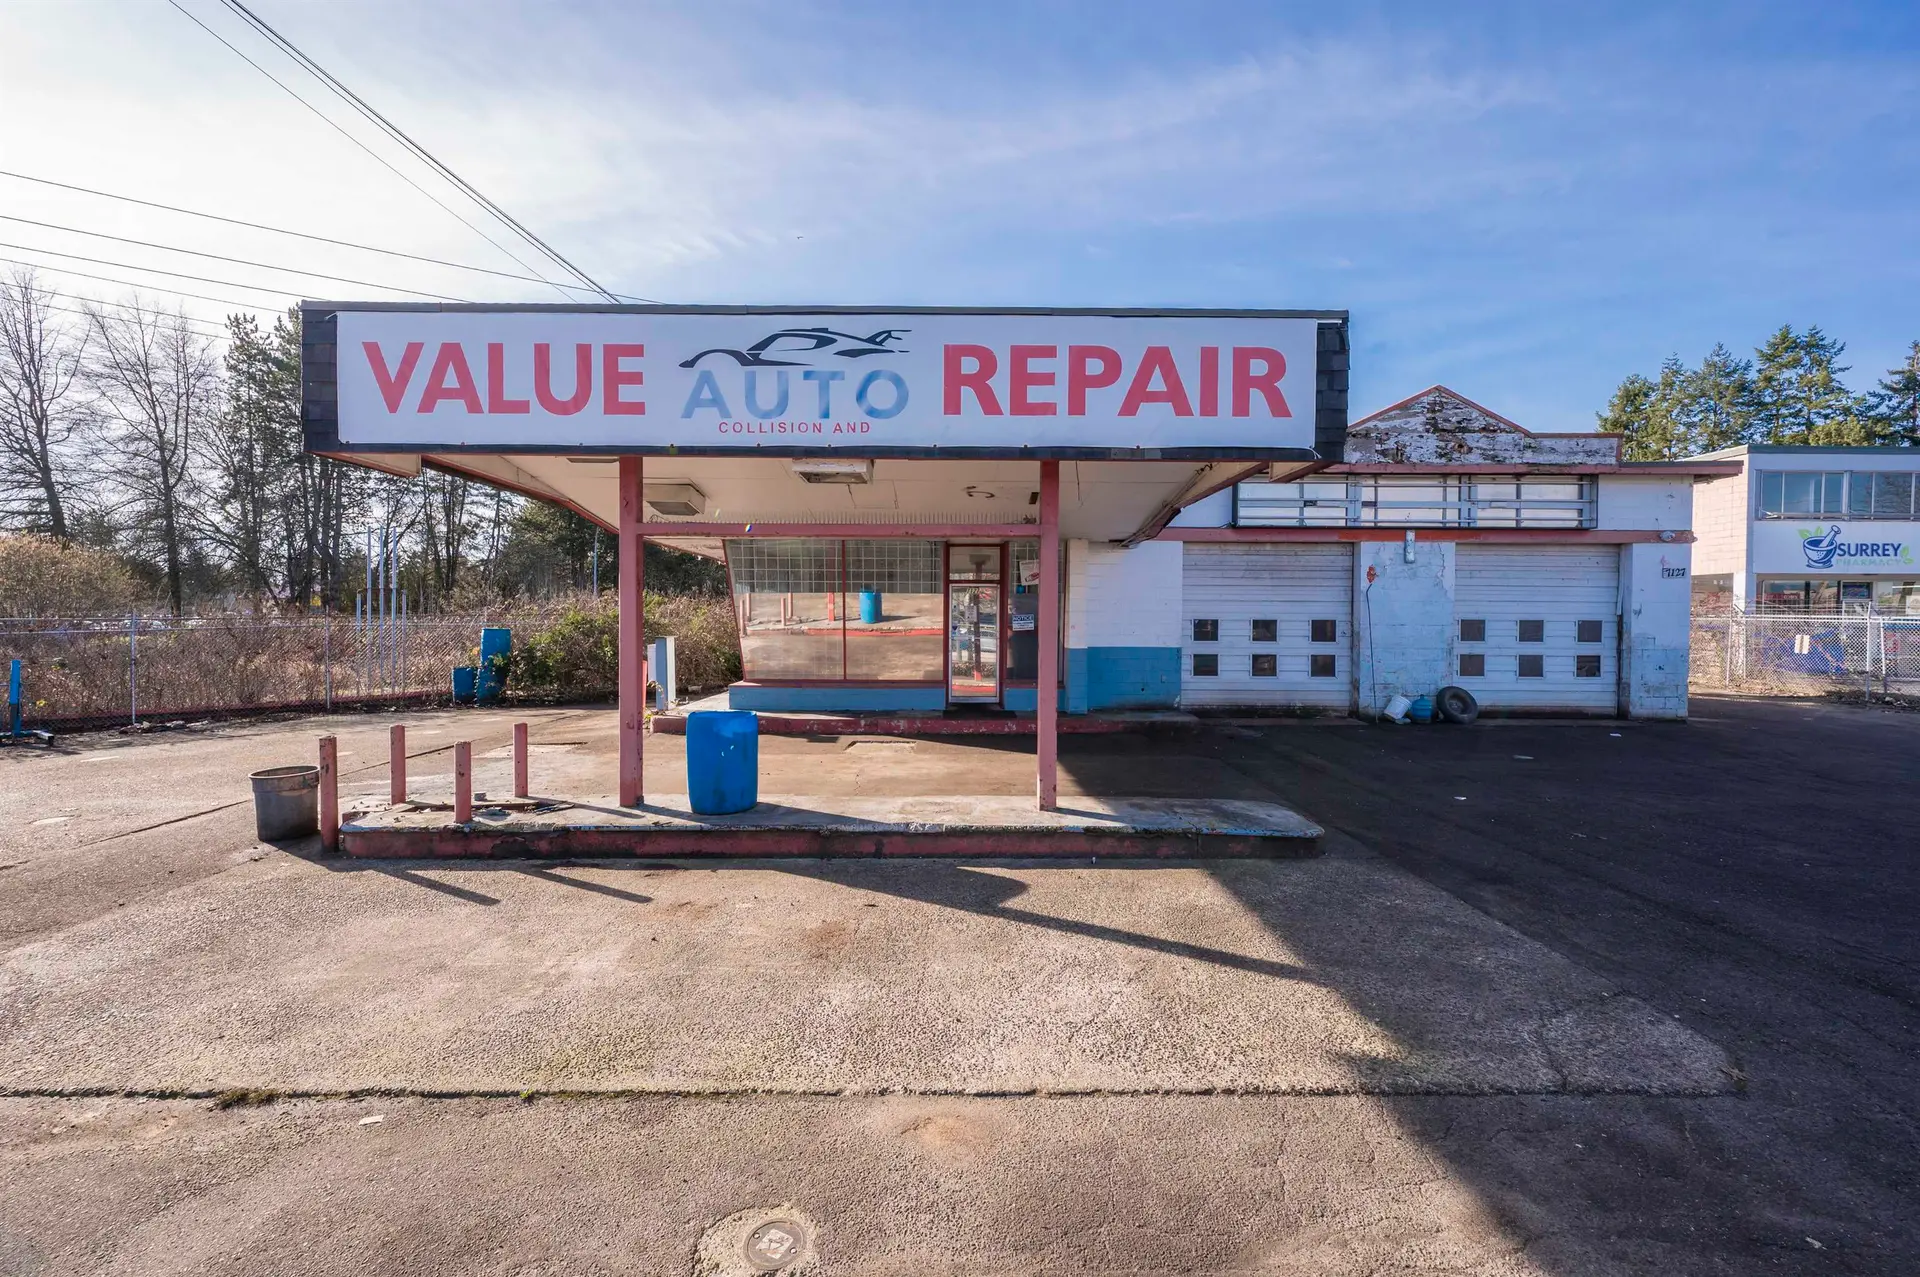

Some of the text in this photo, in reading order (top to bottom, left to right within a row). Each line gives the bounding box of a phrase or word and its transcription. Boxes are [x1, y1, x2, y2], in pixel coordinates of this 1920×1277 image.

[361, 341, 1293, 420] VALUE AUTO REPAIR
[718, 421, 871, 434] COLLISION AND
[1837, 543, 1902, 557] SURREY
[1665, 567, 1687, 578] 7127
